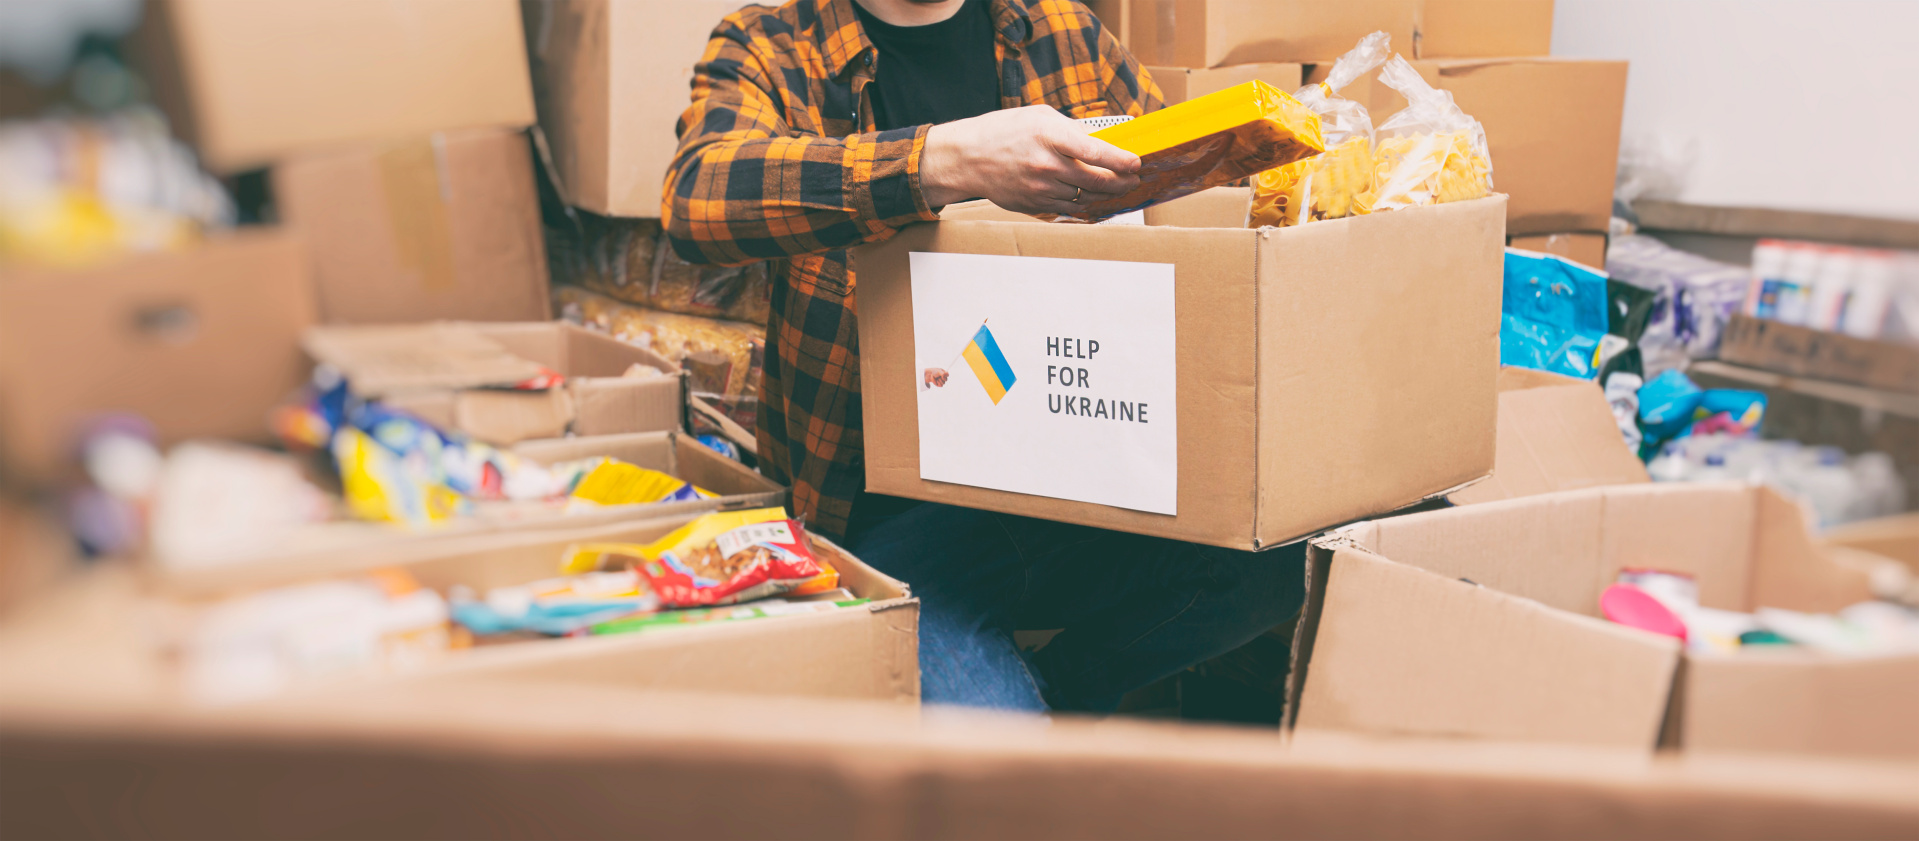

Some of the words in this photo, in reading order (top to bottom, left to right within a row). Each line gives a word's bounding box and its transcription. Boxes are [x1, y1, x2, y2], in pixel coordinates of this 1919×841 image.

[1046, 336, 1101, 360] HELP
[1047, 365, 1090, 389] FOR
[1048, 393, 1149, 424] UKRAINE
